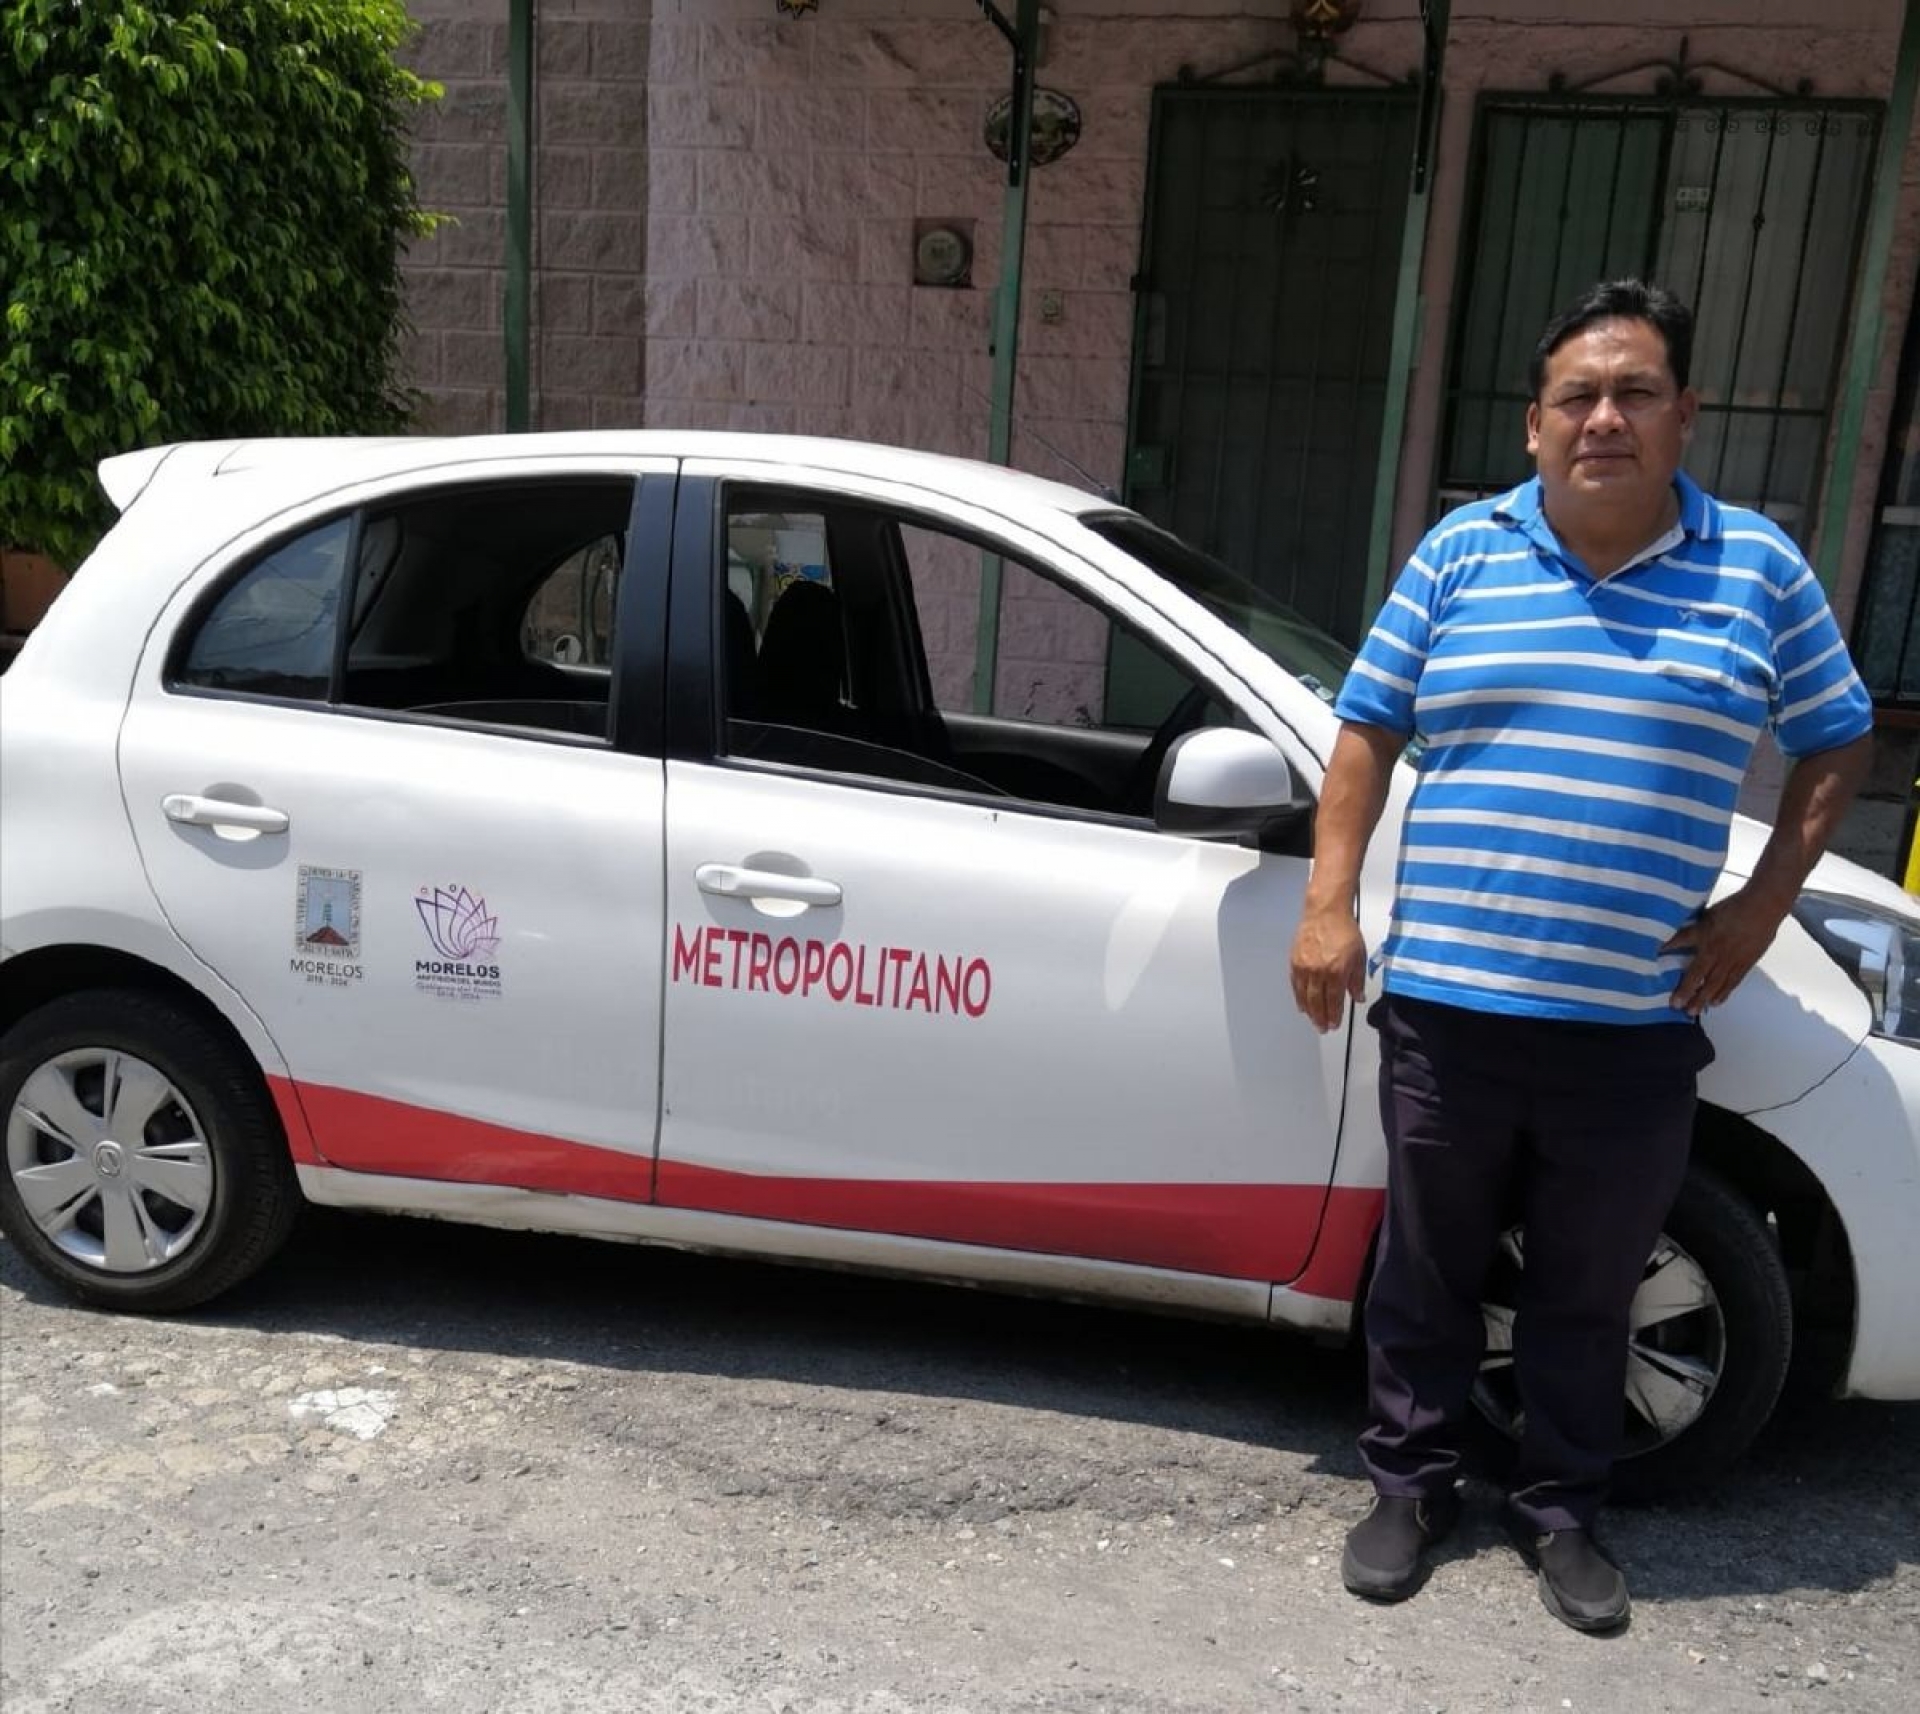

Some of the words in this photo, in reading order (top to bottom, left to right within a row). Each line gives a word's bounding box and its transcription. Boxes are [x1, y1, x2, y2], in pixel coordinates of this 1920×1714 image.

[290, 959, 362, 979] MORELOS
[415, 961, 500, 979] MORELOS
[672, 922, 992, 1018] METROPOLITANO
